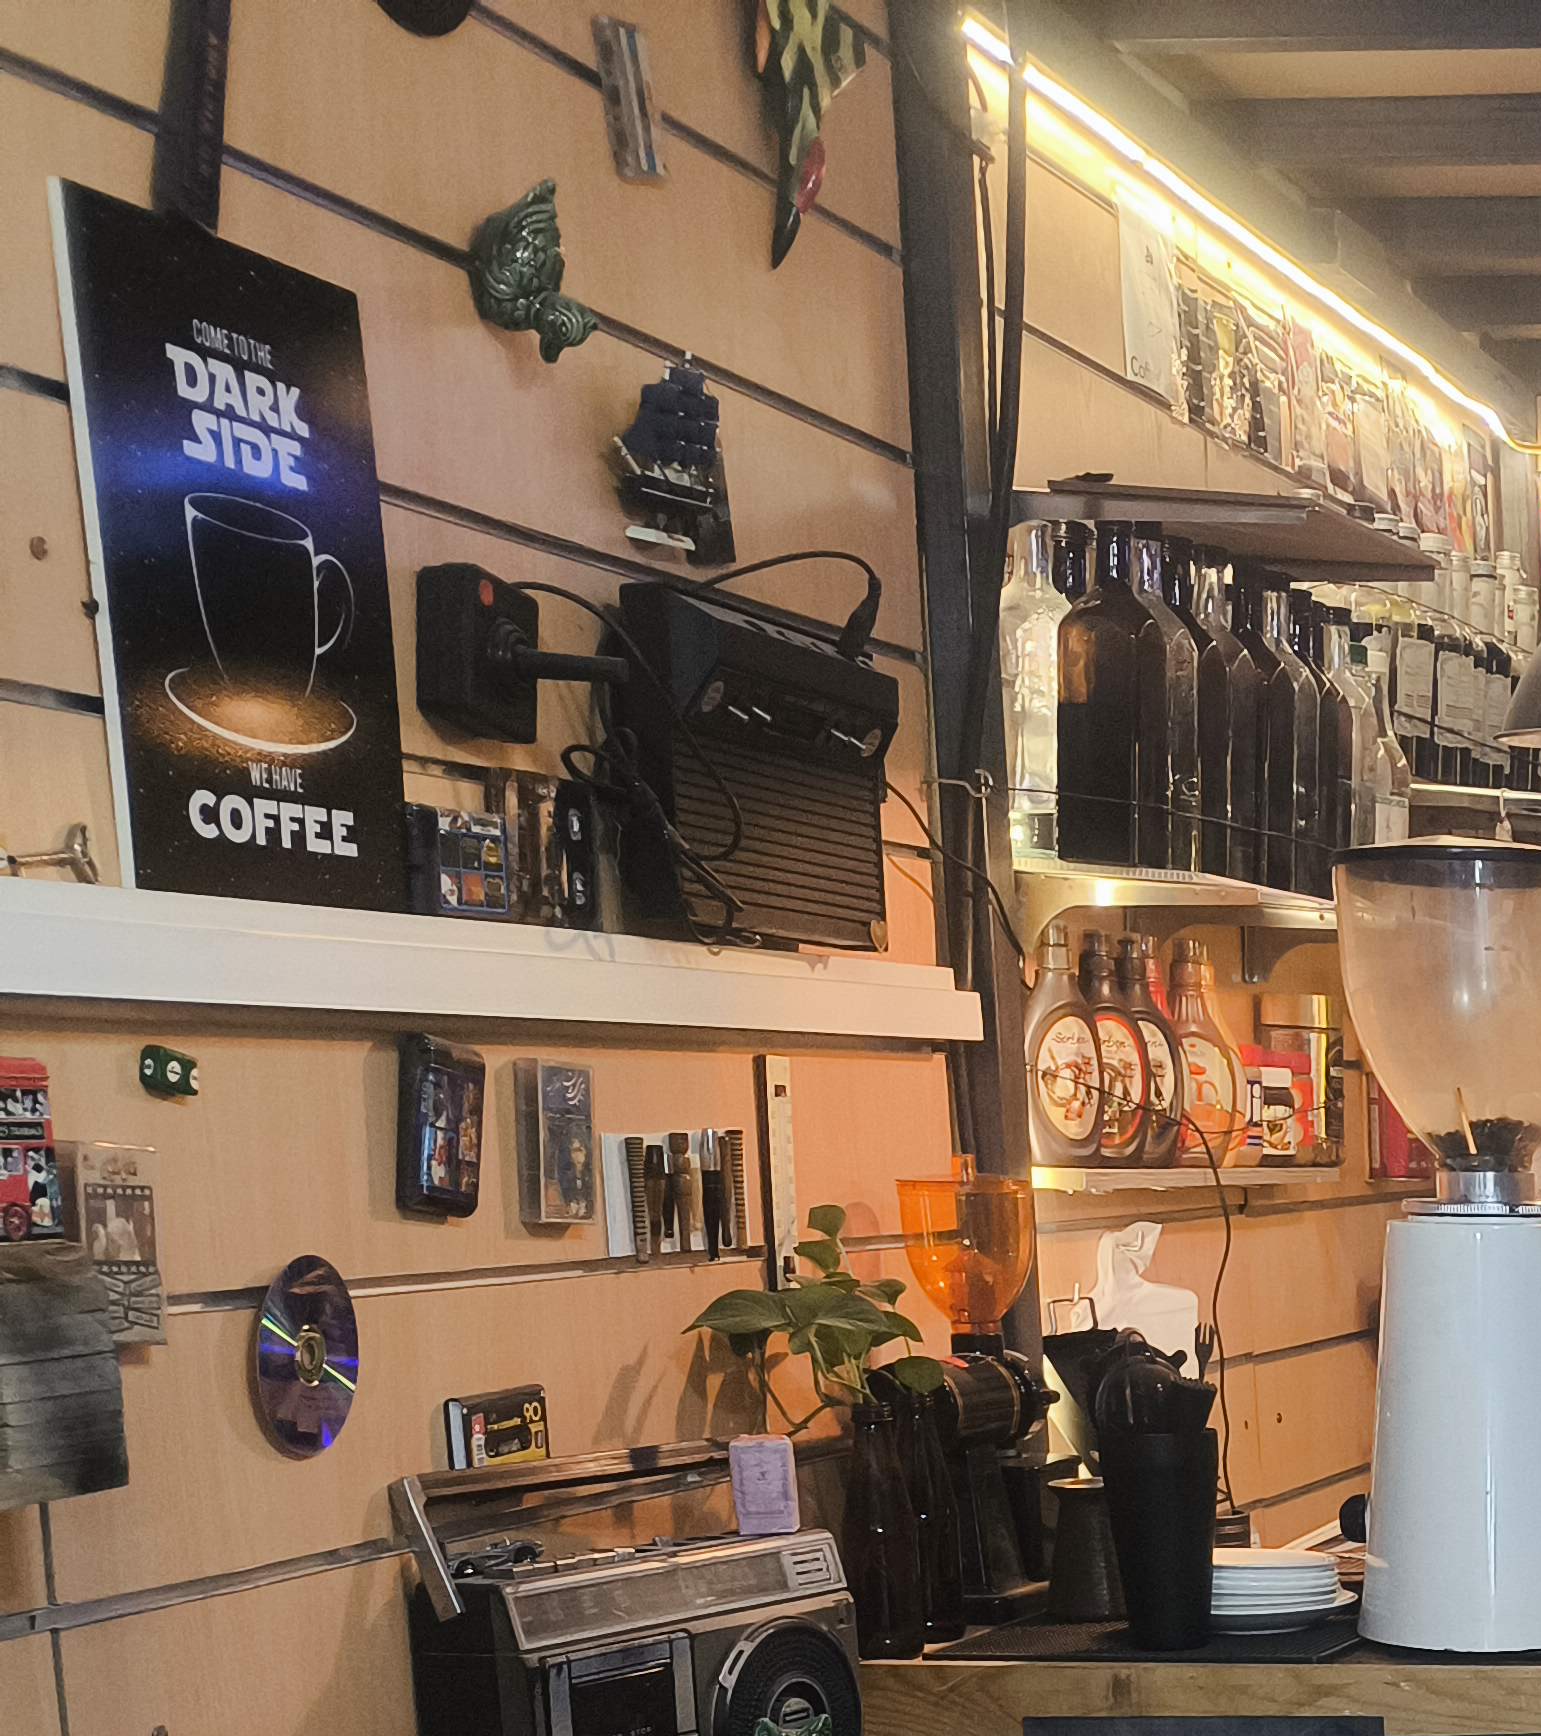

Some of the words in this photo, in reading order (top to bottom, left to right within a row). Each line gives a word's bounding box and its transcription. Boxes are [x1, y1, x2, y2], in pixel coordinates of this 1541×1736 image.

[192, 319, 231, 353] COME
[231, 333, 249, 360] TO
[249, 338, 275, 369] THE
[165, 343, 310, 439] DARK
[183, 409, 308, 491] SIDE
[248, 761, 271, 789] WE
[272, 766, 304, 793] HAVE
[188, 789, 359, 858] COFFEE
[523, 1400, 541, 1422] 90
